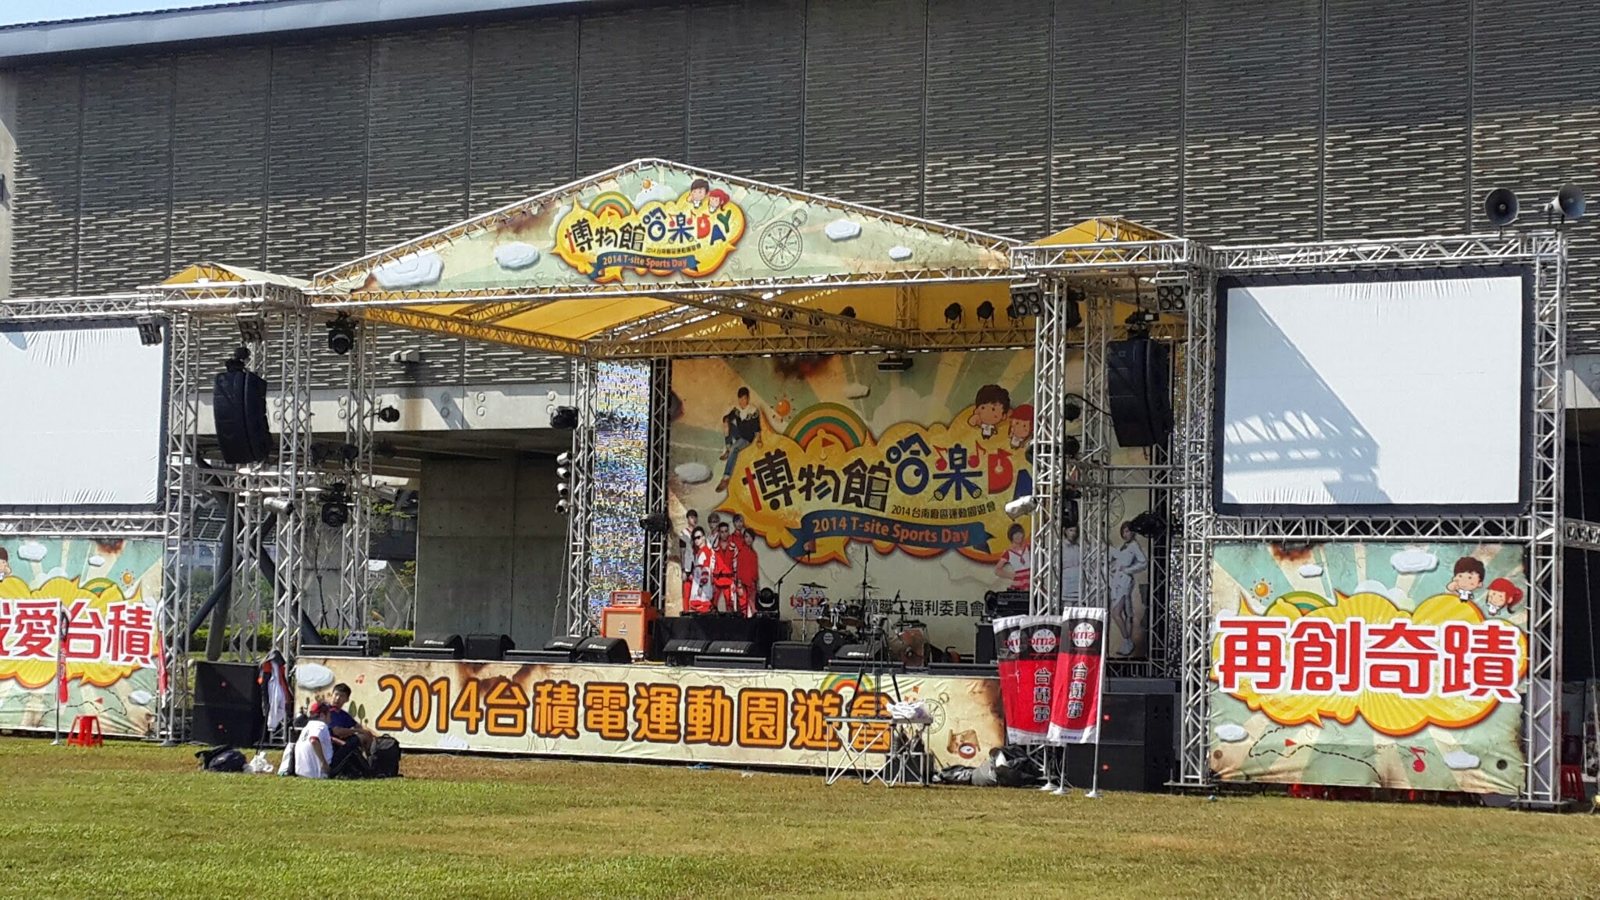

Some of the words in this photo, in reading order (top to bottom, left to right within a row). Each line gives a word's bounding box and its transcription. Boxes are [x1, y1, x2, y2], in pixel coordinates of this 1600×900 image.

[603, 255, 622, 265] 2014
[623, 254, 645, 265] T-site
[645, 257, 670, 269] Sports
[671, 258, 687, 269] Day
[812, 516, 847, 533] 2014
[851, 516, 889, 536] T-site
[892, 521, 938, 543] Sports
[941, 528, 969, 545] Day
[1218, 618, 1518, 699] 再創奇蹟
[376, 674, 894, 753] 2014台積電運動園遊會
